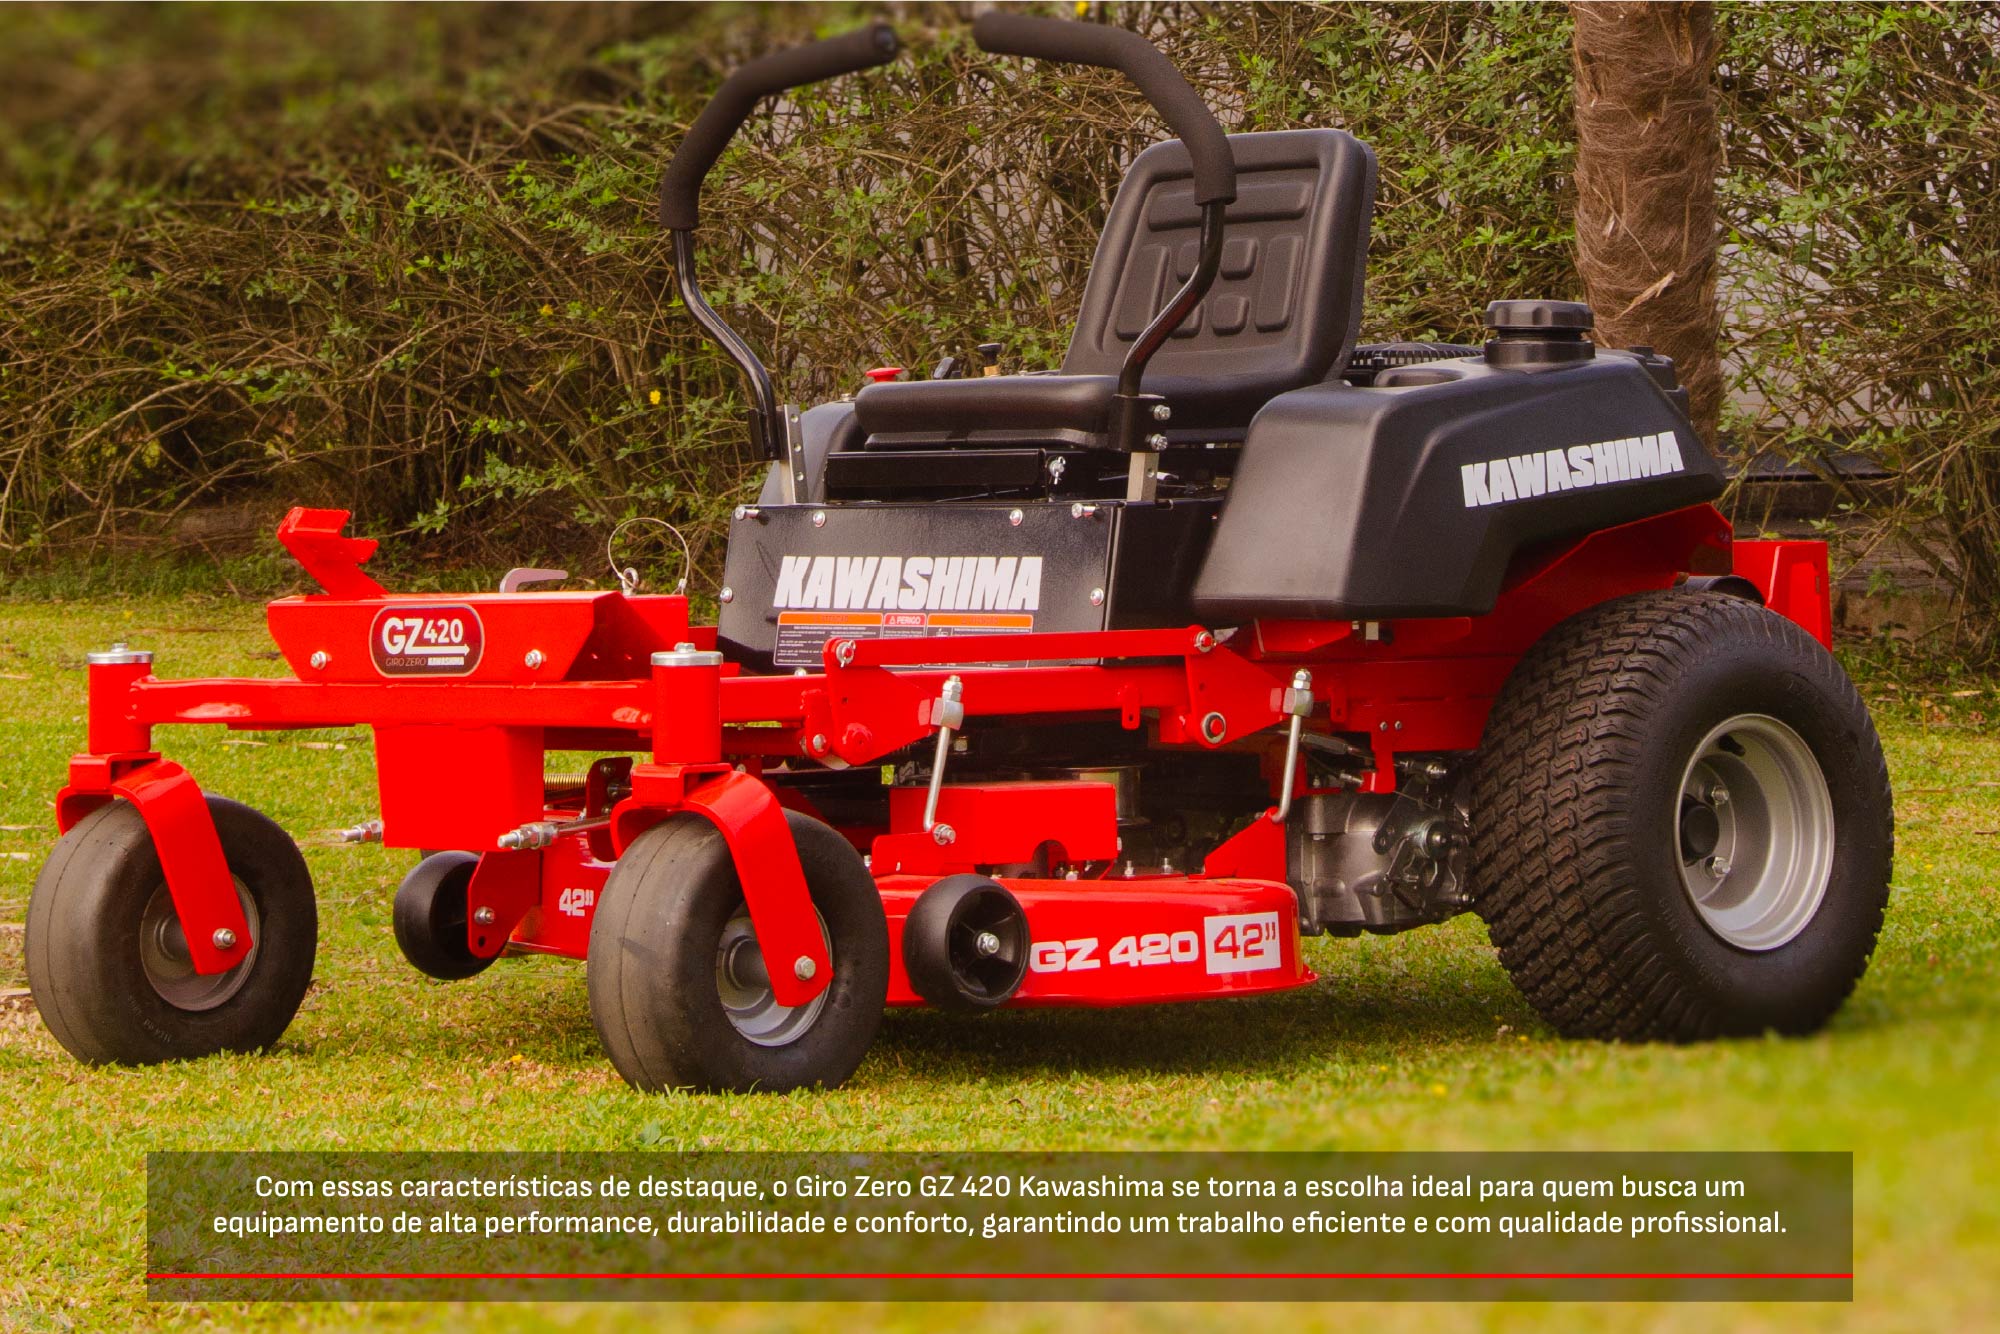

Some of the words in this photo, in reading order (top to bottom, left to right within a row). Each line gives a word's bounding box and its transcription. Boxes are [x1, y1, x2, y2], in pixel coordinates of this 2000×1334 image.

[1461, 431, 1685, 507] KAWASHIMA
[773, 556, 1043, 610] KAWASHIMA
[385, 657, 405, 667] GIRO
[405, 657, 427, 667] ZERO
[1029, 937, 1101, 973] GZ
[1109, 930, 1199, 967] 420
